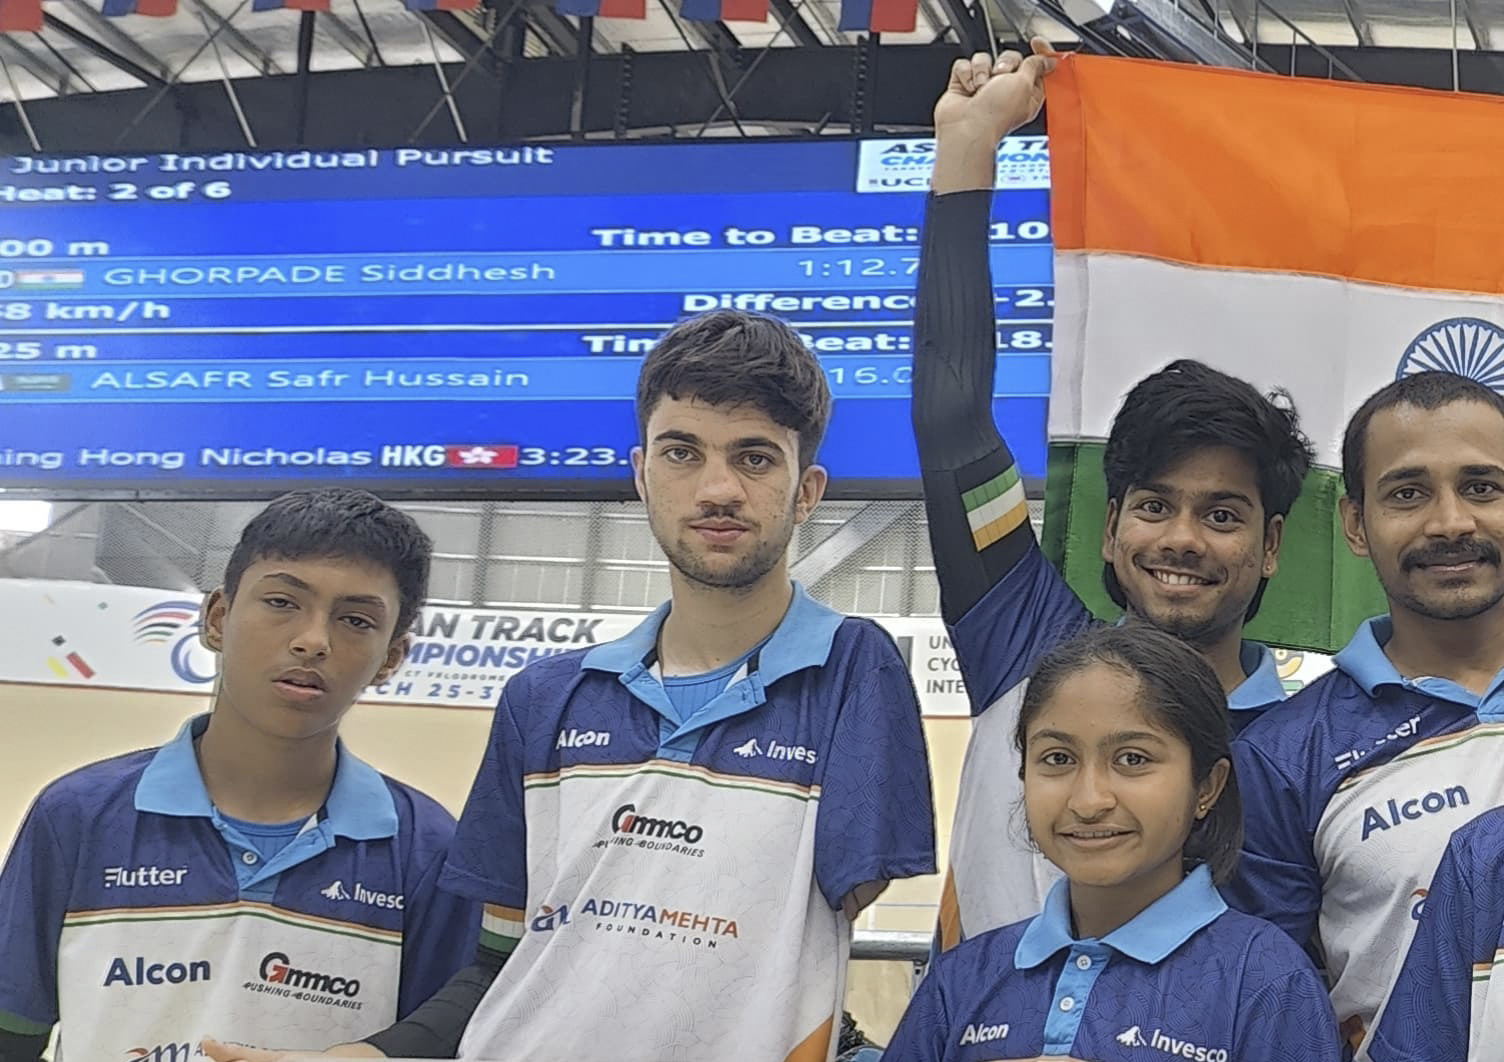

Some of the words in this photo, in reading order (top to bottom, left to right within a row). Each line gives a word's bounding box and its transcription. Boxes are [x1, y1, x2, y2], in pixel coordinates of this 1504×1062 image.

[10, 155, 149, 174] Junior
[158, 150, 379, 173] Individual
[396, 146, 555, 167] Pursuit
[107, 183, 139, 199] 2
[150, 181, 196, 199] of
[203, 181, 233, 198] 6
[68, 240, 109, 255] m
[592, 229, 711, 247] Time
[725, 227, 775, 246] to
[790, 225, 919, 245] Beat:
[104, 265, 346, 286] GHORPADE
[361, 263, 556, 283] Siddhesh
[46, 300, 170, 321] km/h
[56, 344, 97, 359] m
[582, 335, 662, 353] Tim
[91, 371, 252, 389] ALSAFR
[267, 368, 349, 388] Safr
[365, 367, 529, 387] Hussain
[80, 448, 184, 470] Hong
[201, 447, 372, 468] Nicholas
[381, 444, 446, 467] HKG
[471, 615, 604, 644] TRACK
[556, 729, 610, 750] Alcon
[767, 740, 818, 764] Inves
[1361, 783, 1470, 842] Alcon
[104, 865, 188, 889] Flutter
[353, 883, 405, 910] Invesc
[595, 923, 718, 949] FOUNDATION
[103, 956, 211, 987] Alcon
[960, 1022, 1010, 1046] Alcon
